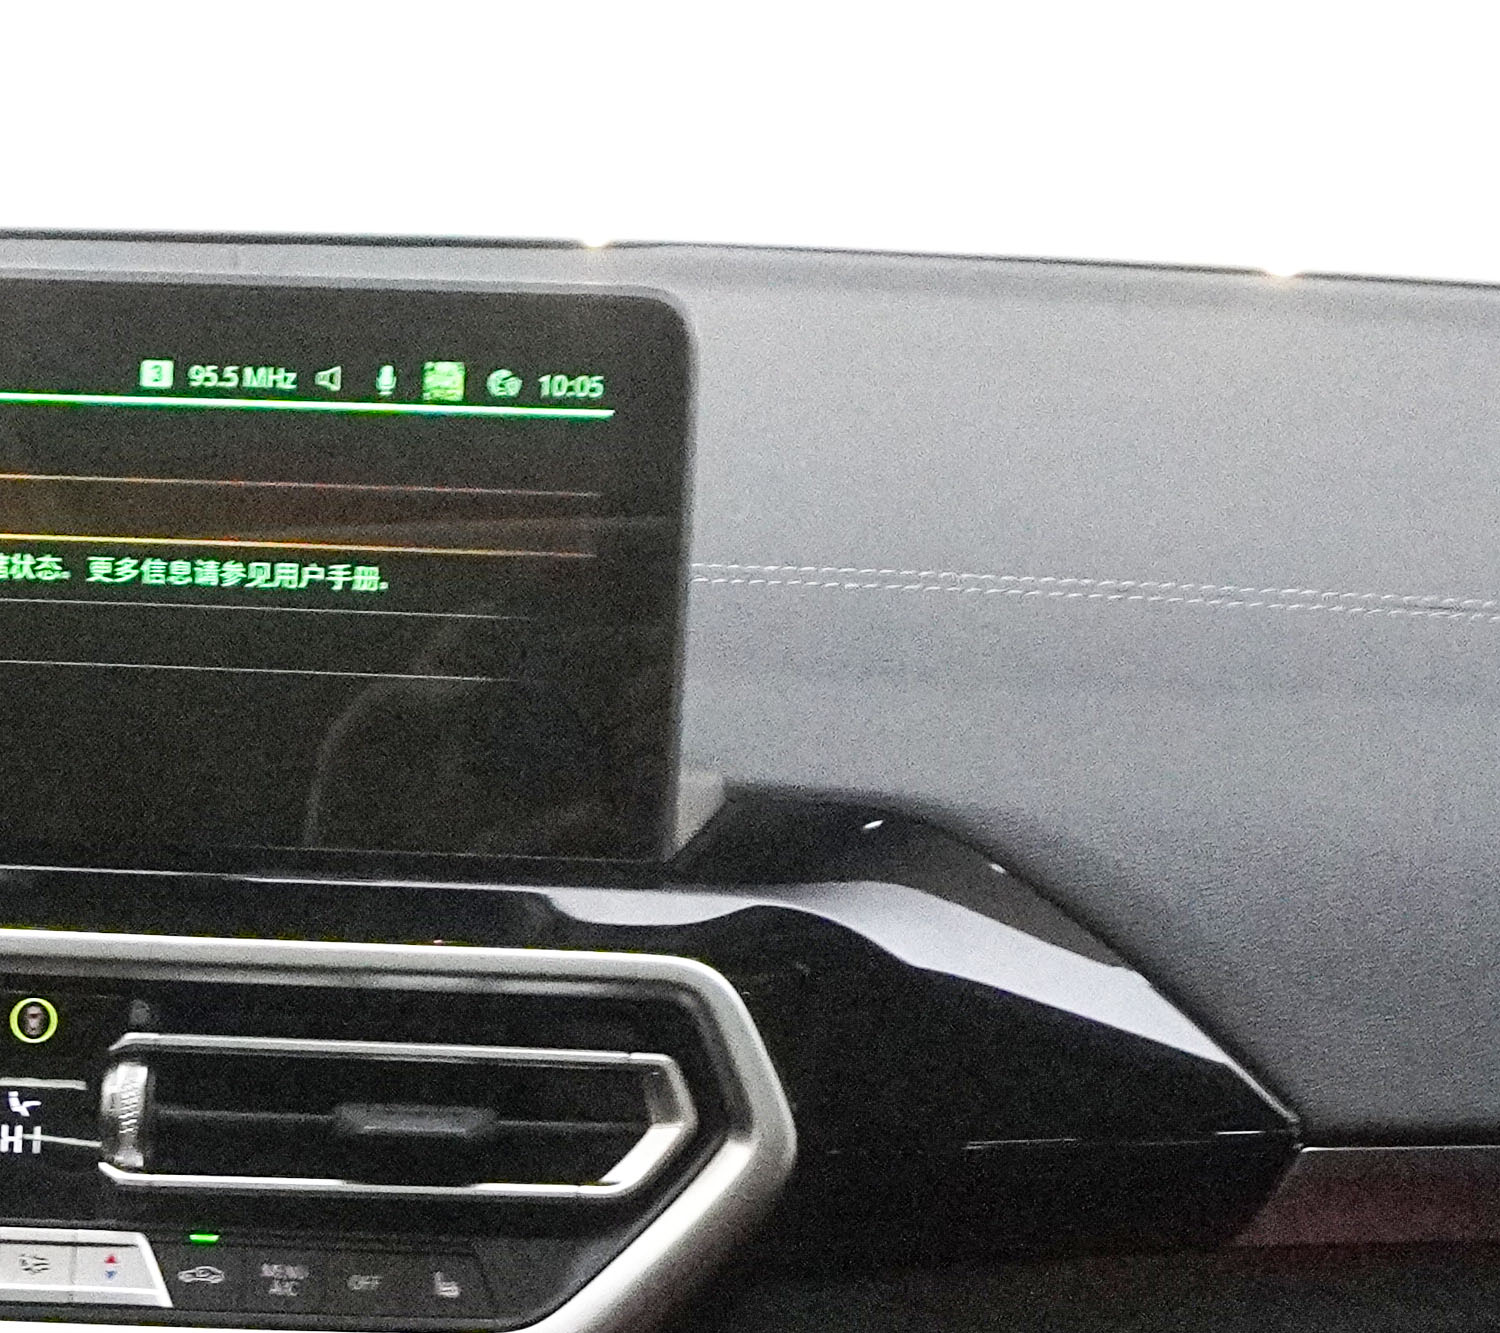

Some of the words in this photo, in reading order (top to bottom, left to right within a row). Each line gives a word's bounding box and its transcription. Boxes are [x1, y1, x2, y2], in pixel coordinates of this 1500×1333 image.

[187, 364, 239, 388] 95.5
[242, 366, 297, 390] MHz
[538, 373, 605, 398] 10:05
[0, 1124, 42, 1155] HI
